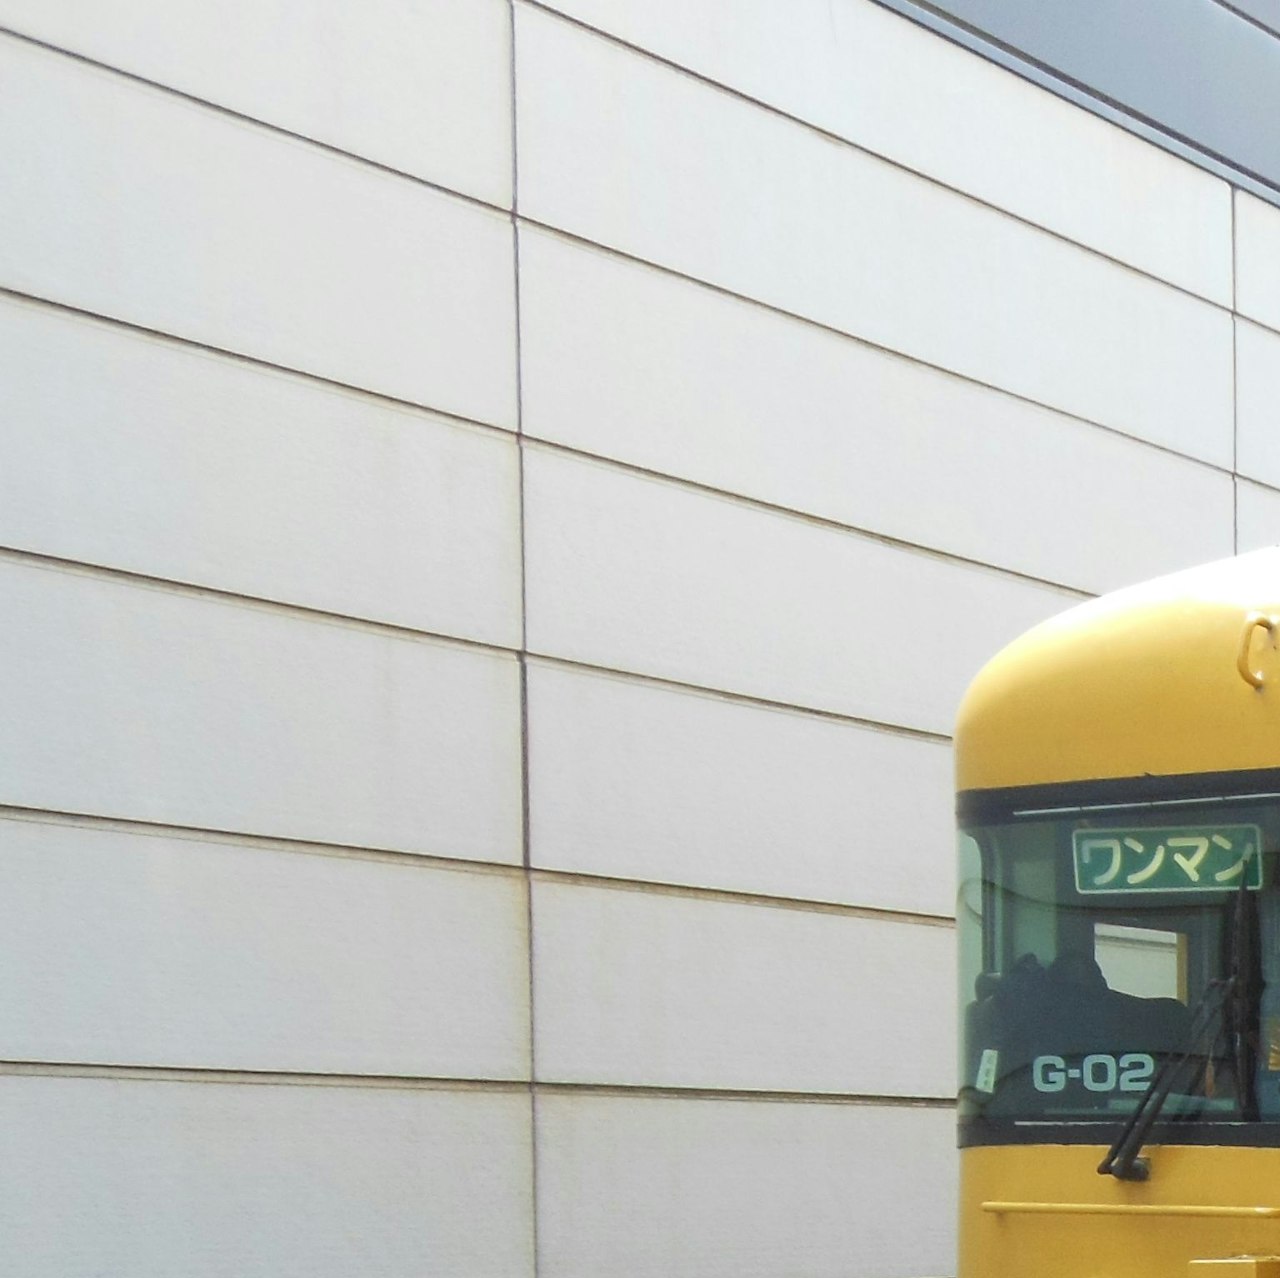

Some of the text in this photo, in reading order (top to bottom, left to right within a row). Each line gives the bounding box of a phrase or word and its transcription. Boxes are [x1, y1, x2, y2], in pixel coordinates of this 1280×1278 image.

[1081, 833, 1254, 886] ワンマン
[1032, 1053, 1155, 1093] G-02
